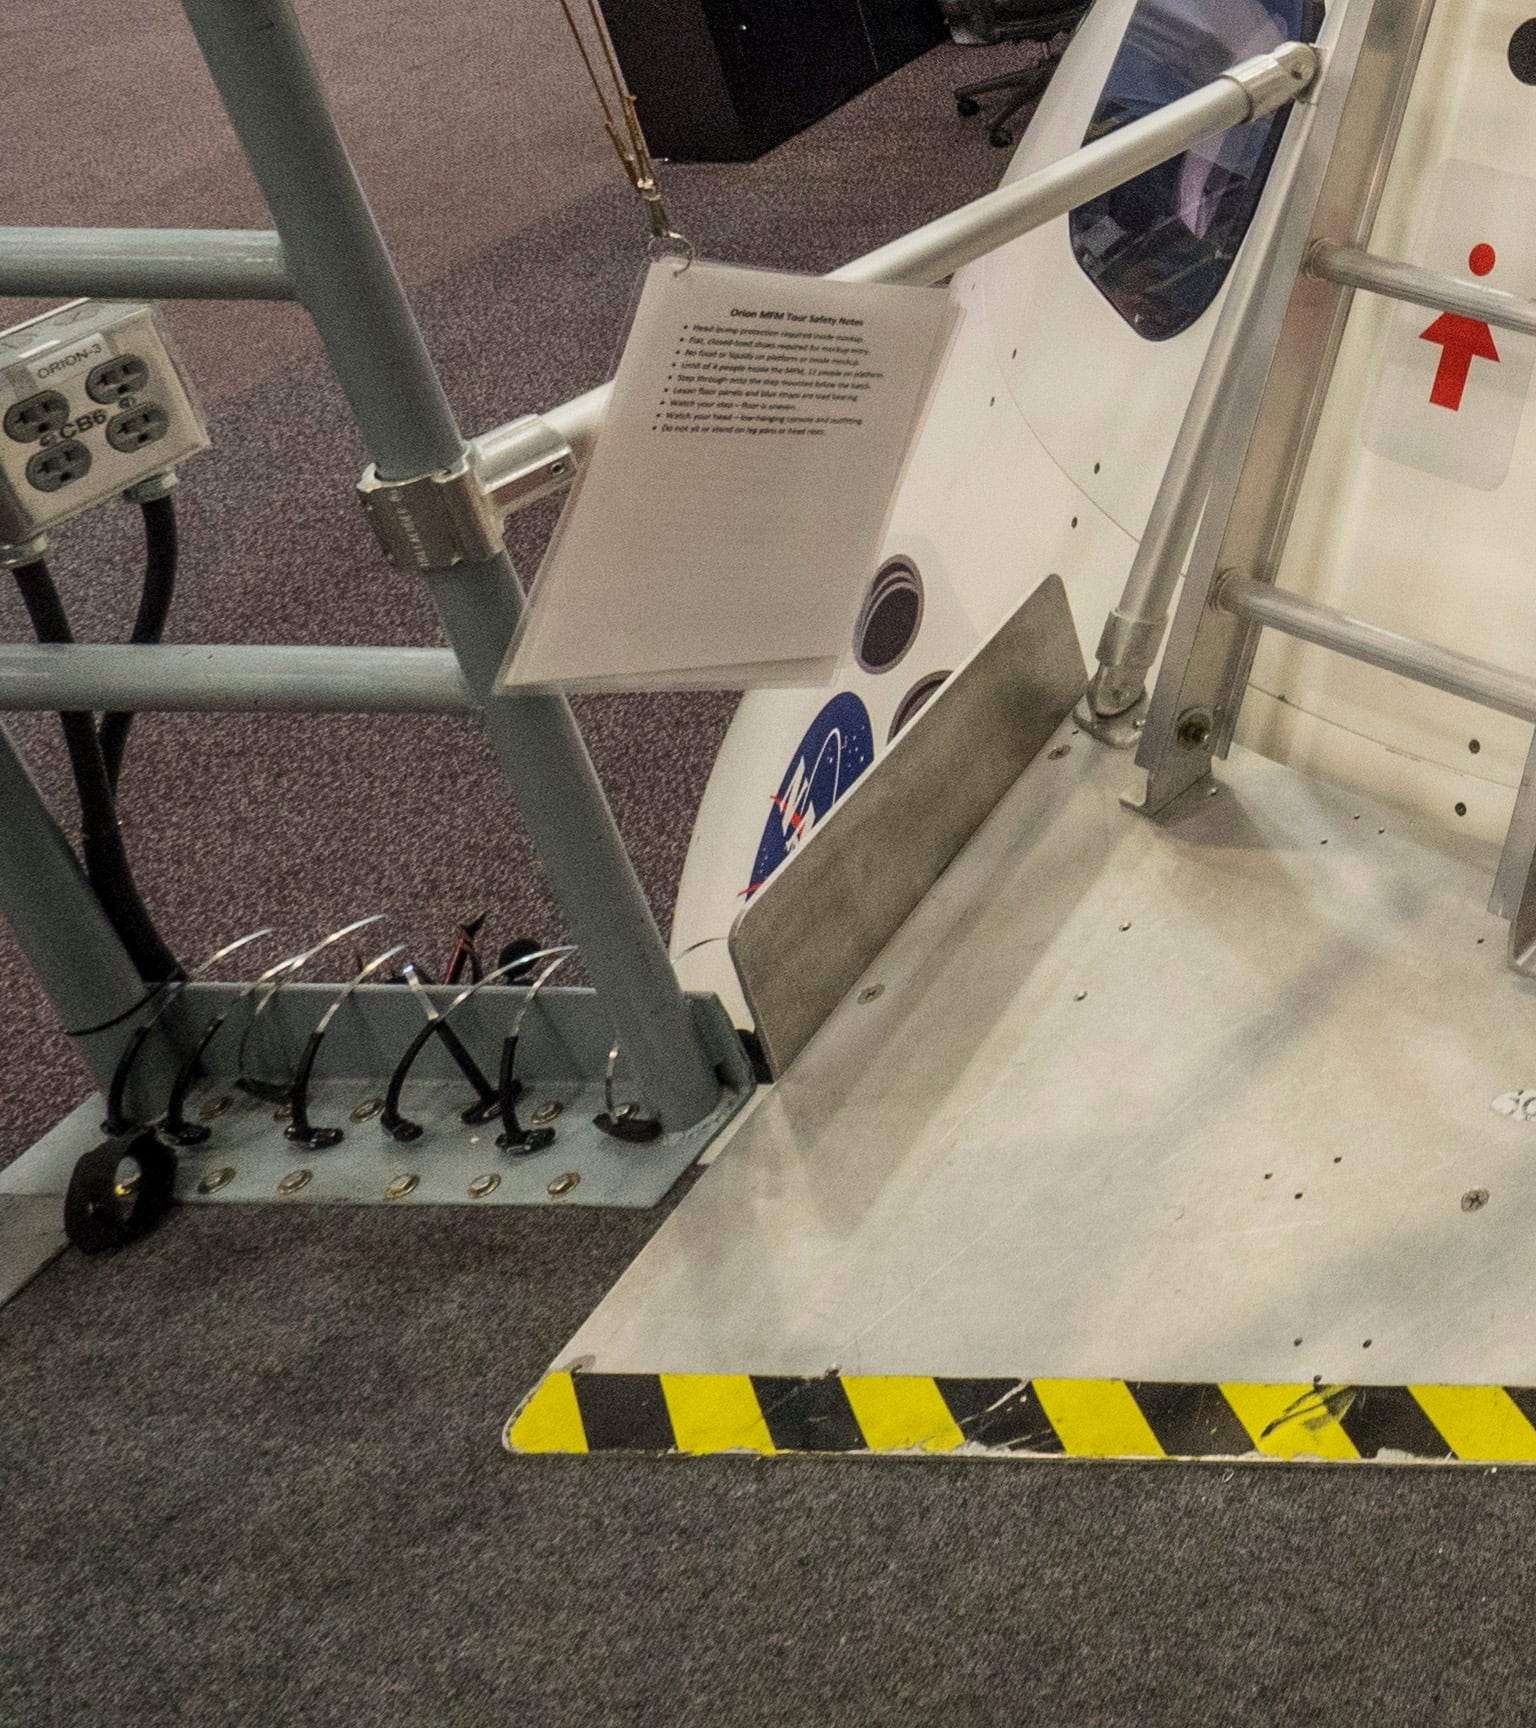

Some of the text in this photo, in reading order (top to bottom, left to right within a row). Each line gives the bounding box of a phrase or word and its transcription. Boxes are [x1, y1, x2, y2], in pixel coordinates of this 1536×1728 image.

[730, 308, 864, 327] Orion MFM Tour Safety Notes
[37, 343, 103, 380] ORION-3
[59, 408, 108, 440] CB6
